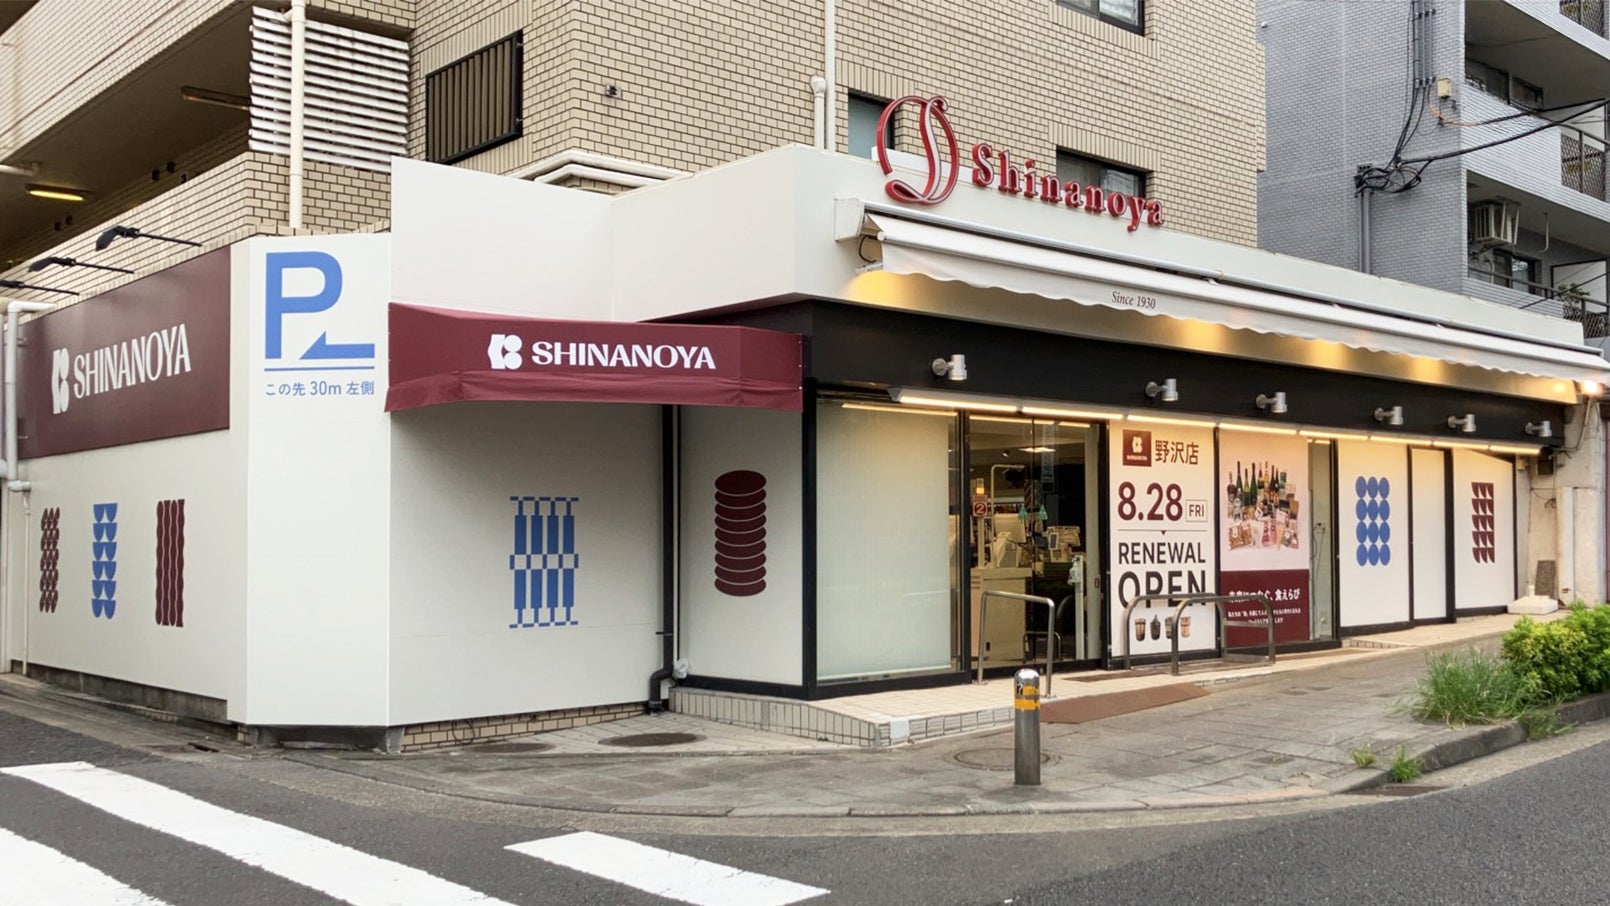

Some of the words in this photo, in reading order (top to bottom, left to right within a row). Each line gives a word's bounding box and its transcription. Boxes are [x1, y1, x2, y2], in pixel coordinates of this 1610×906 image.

[972, 142, 1164, 232] Shinanoya
[264, 251, 343, 360] P
[1112, 291, 1134, 306] Since
[1137, 296, 1156, 309] 1930
[73, 323, 192, 400] SHINANOYA
[531, 341, 717, 370] SHINANOYA
[265, 382, 307, 396] この先
[310, 381, 342, 396] 30m
[346, 380, 375, 396] 左側
[1155, 440, 1199, 465] 野沢店
[1118, 481, 1183, 521] 8.28
[1189, 505, 1205, 517] FRI
[1118, 542, 1206, 564] RENEWAL
[1118, 570, 1206, 608] OPEN
